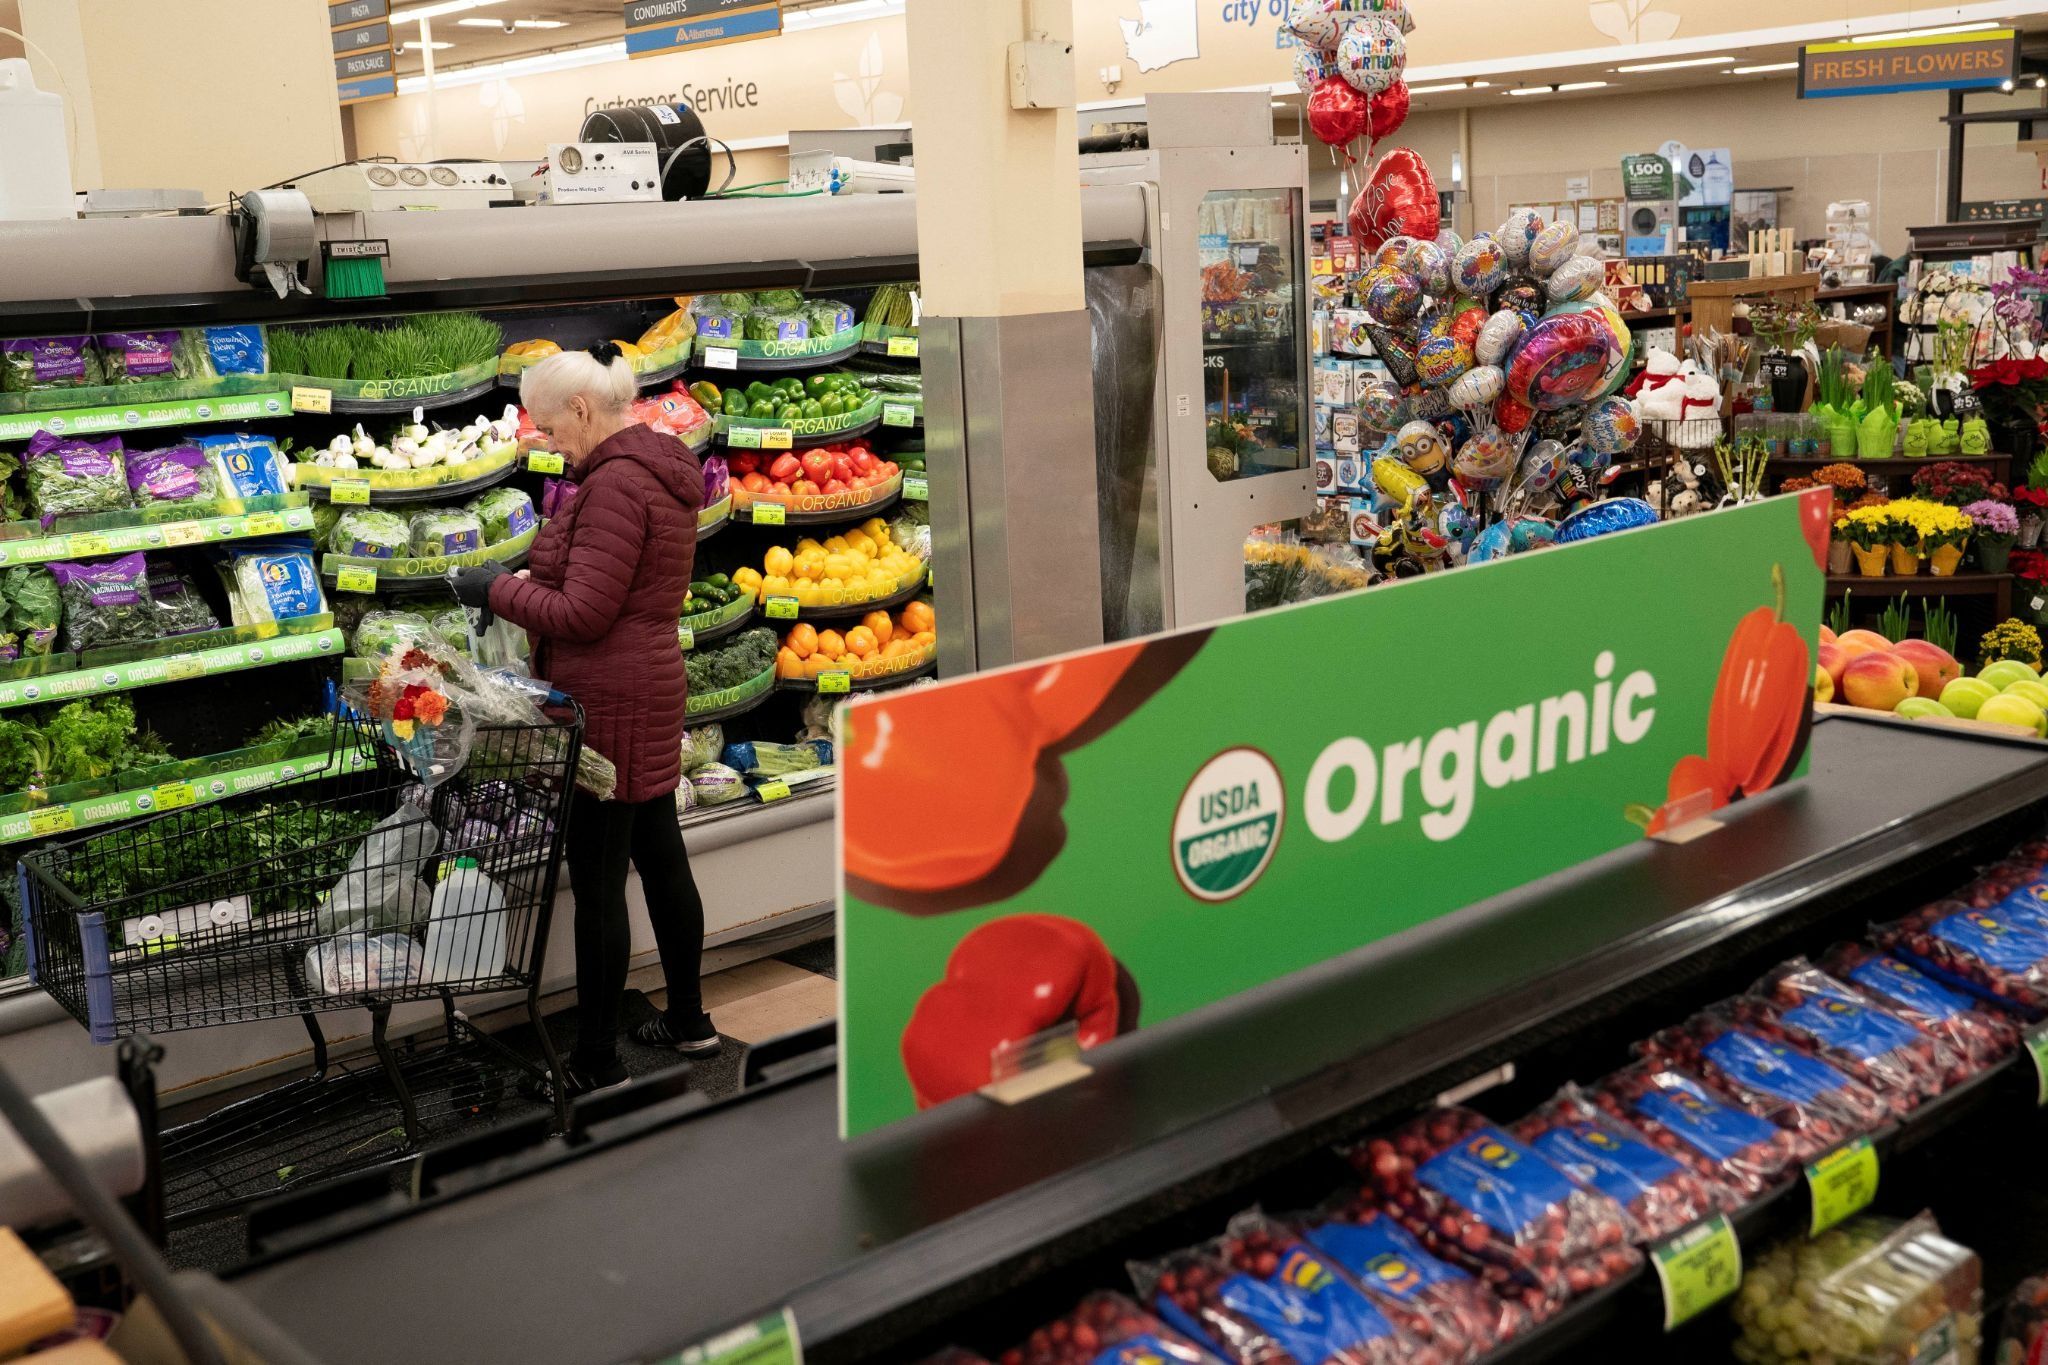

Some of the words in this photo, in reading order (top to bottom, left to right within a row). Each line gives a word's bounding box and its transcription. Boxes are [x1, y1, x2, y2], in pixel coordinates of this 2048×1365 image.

[351, 5, 370, 18] PASTA
[634, 0, 687, 21] CONDIMENTS
[356, 32, 369, 44] AND
[347, 60, 365, 72] PASTA
[366, 56, 385, 71] SAUCE
[1813, 58, 1885, 81] FRESH
[1891, 49, 2005, 76] FLOWERS
[682, 77, 758, 113] Service
[1628, 163, 1664, 177] 1,500
[764, 336, 833, 357] ORGANIC
[363, 375, 453, 397] ORGANIC
[148, 407, 192, 422] ORGANIC
[219, 401, 261, 417] ORGANIC
[75, 413, 120, 429] ORGANIC
[782, 412, 852, 434] ORGANIC
[802, 488, 873, 512] ORGANIC
[17, 543, 65, 559] ORGANIC
[405, 551, 484, 575] ORGANI
[832, 580, 900, 603] ORGANIC
[681, 611, 723, 628] ANIC
[272, 640, 313, 658] ORGANIC
[128, 664, 167, 683] ORGANI
[851, 652, 920, 677] ORGANIC
[51, 676, 97, 695] ORGANIC
[687, 687, 741, 713] GANIC
[1304, 650, 1657, 844] Organic
[233, 770, 277, 790] ORGANIC
[83, 800, 131, 820] ORGANIC
[1200, 780, 1260, 825] USDA
[2, 820, 32, 838] ORGA
[1187, 819, 1270, 870] ORGANIC
